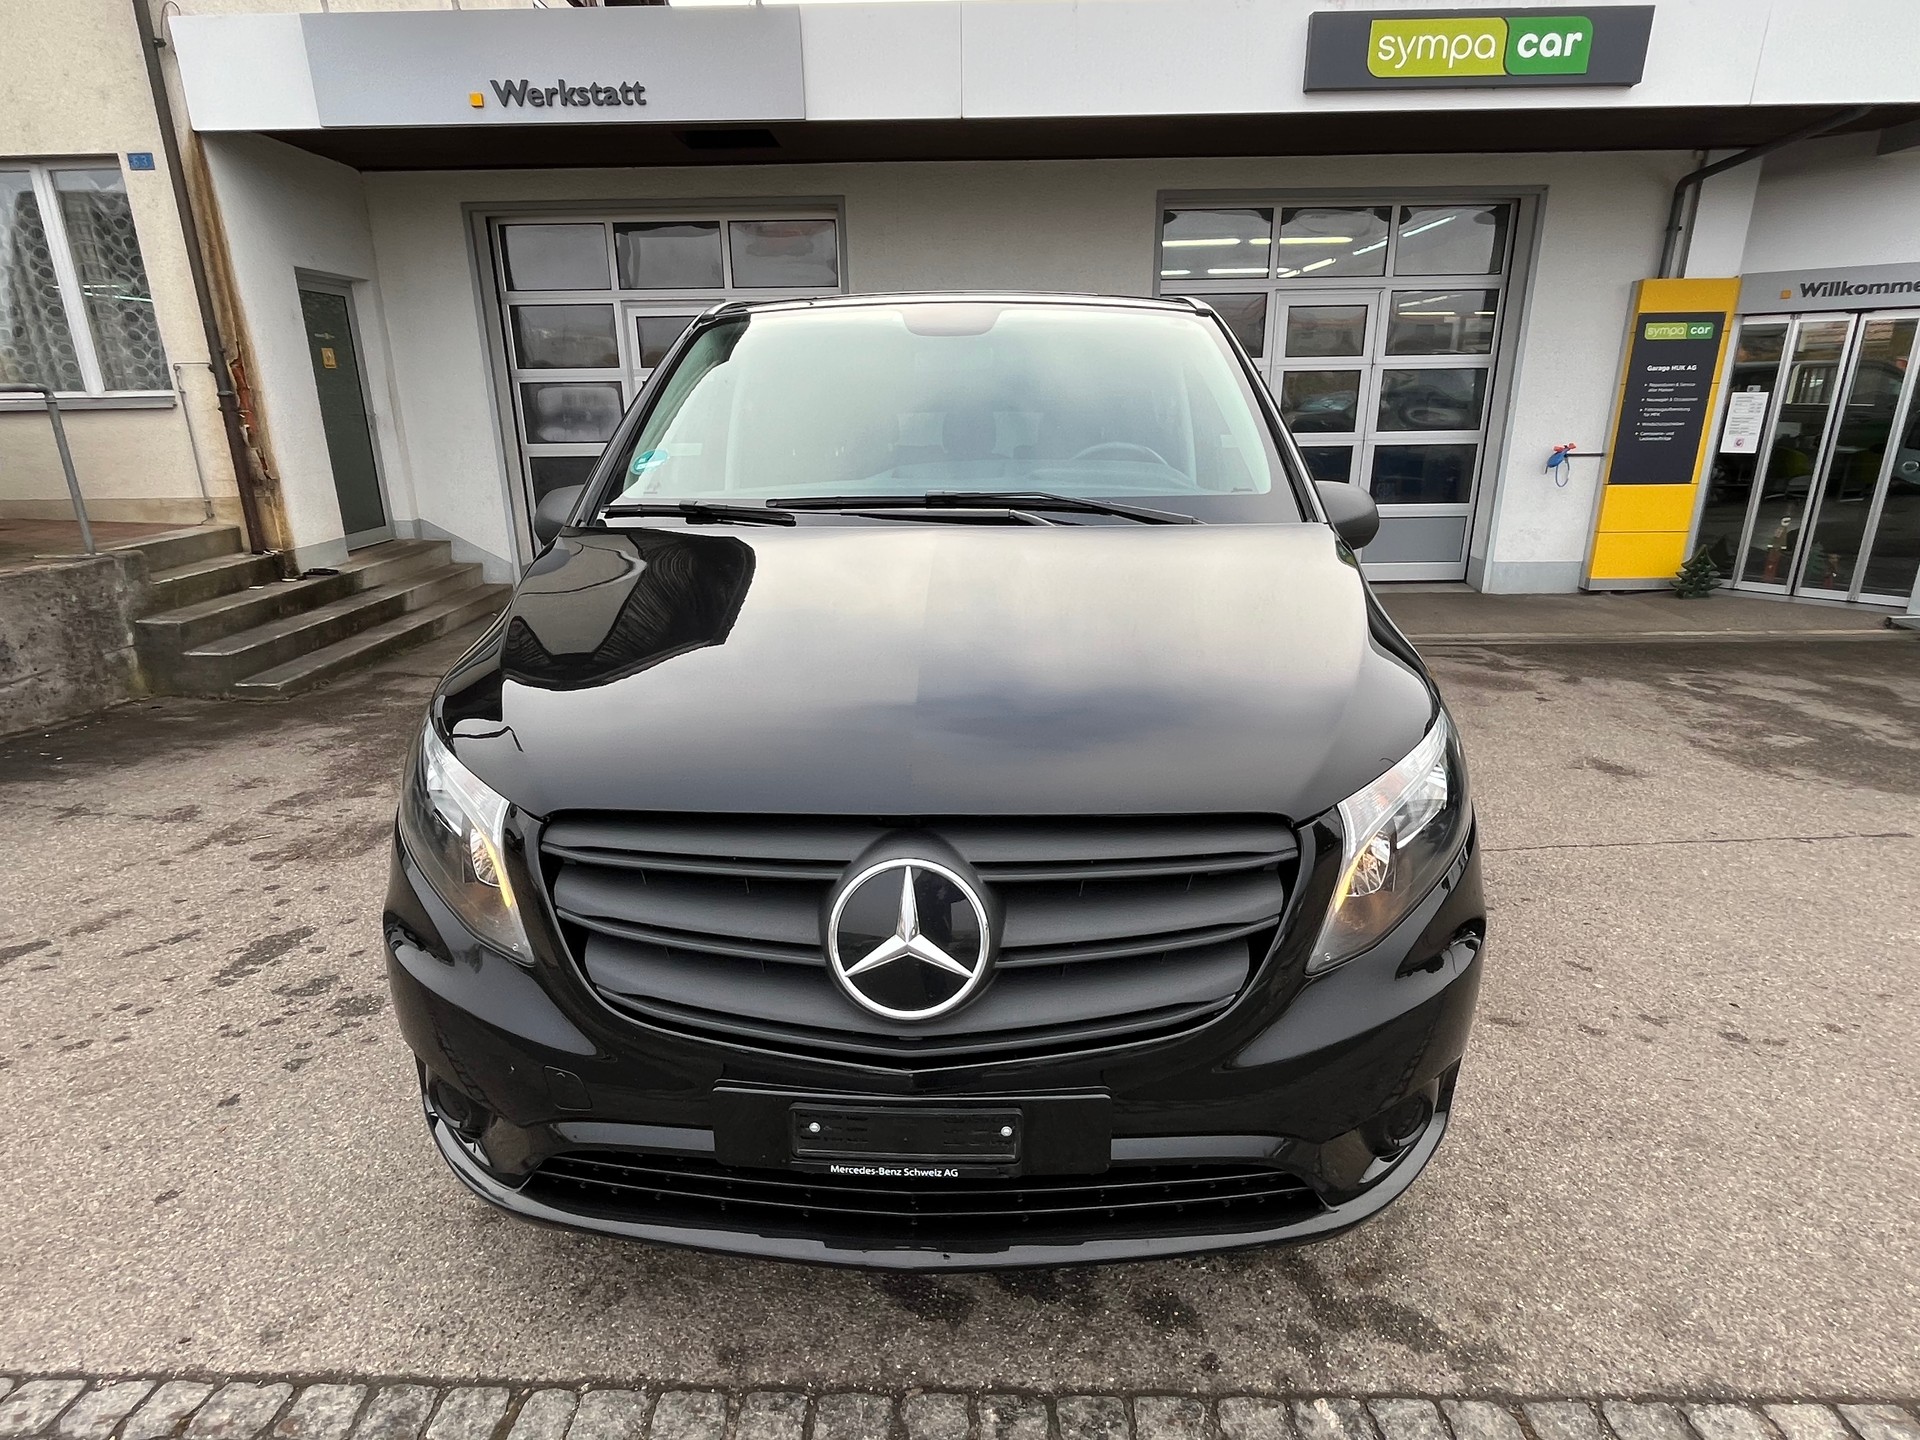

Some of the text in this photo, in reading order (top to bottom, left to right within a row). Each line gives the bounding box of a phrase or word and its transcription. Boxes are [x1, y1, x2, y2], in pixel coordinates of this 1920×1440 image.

[1377, 31, 1583, 69] sympa car
[489, 79, 648, 107] Werkstatt
[1647, 326, 1711, 338] sympa car
[830, 1164, 959, 1178] Mercedes-Benz Schweiz AG
